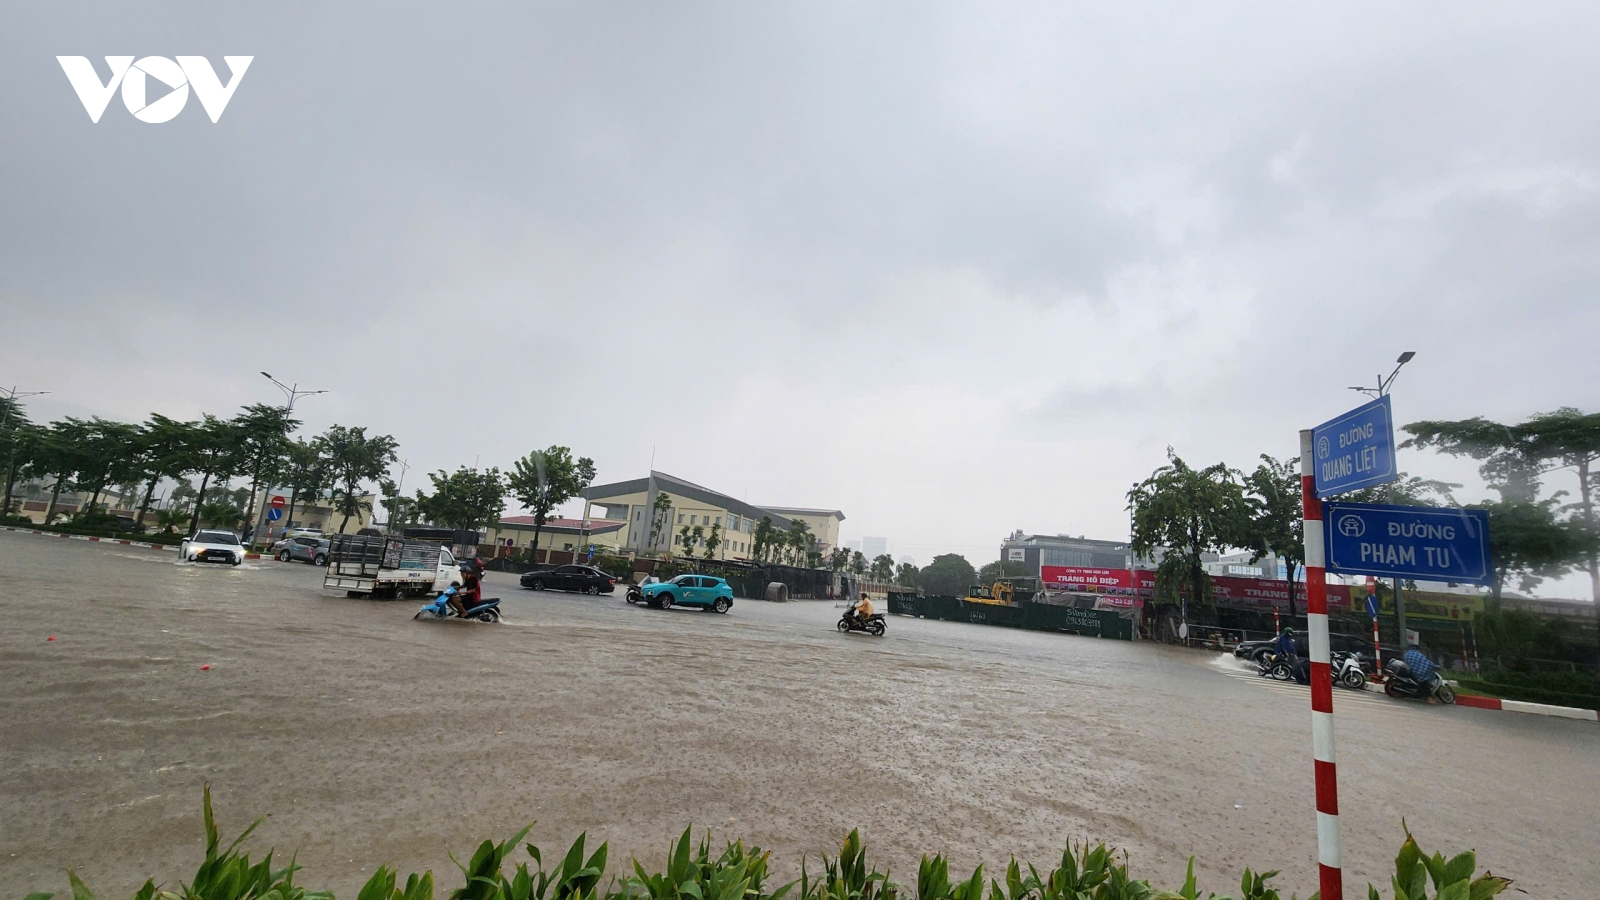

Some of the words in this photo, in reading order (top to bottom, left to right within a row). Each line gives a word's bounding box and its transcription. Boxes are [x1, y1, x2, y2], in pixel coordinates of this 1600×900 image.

[1339, 422, 1374, 448] ĐƯỜNG
[1322, 456, 1352, 482] QUANG
[1356, 445, 1377, 474] LIỆT
[1388, 519, 1456, 540] ĐƯỜNG
[1360, 542, 1416, 568] PHẠM
[1424, 546, 1450, 568] TU
